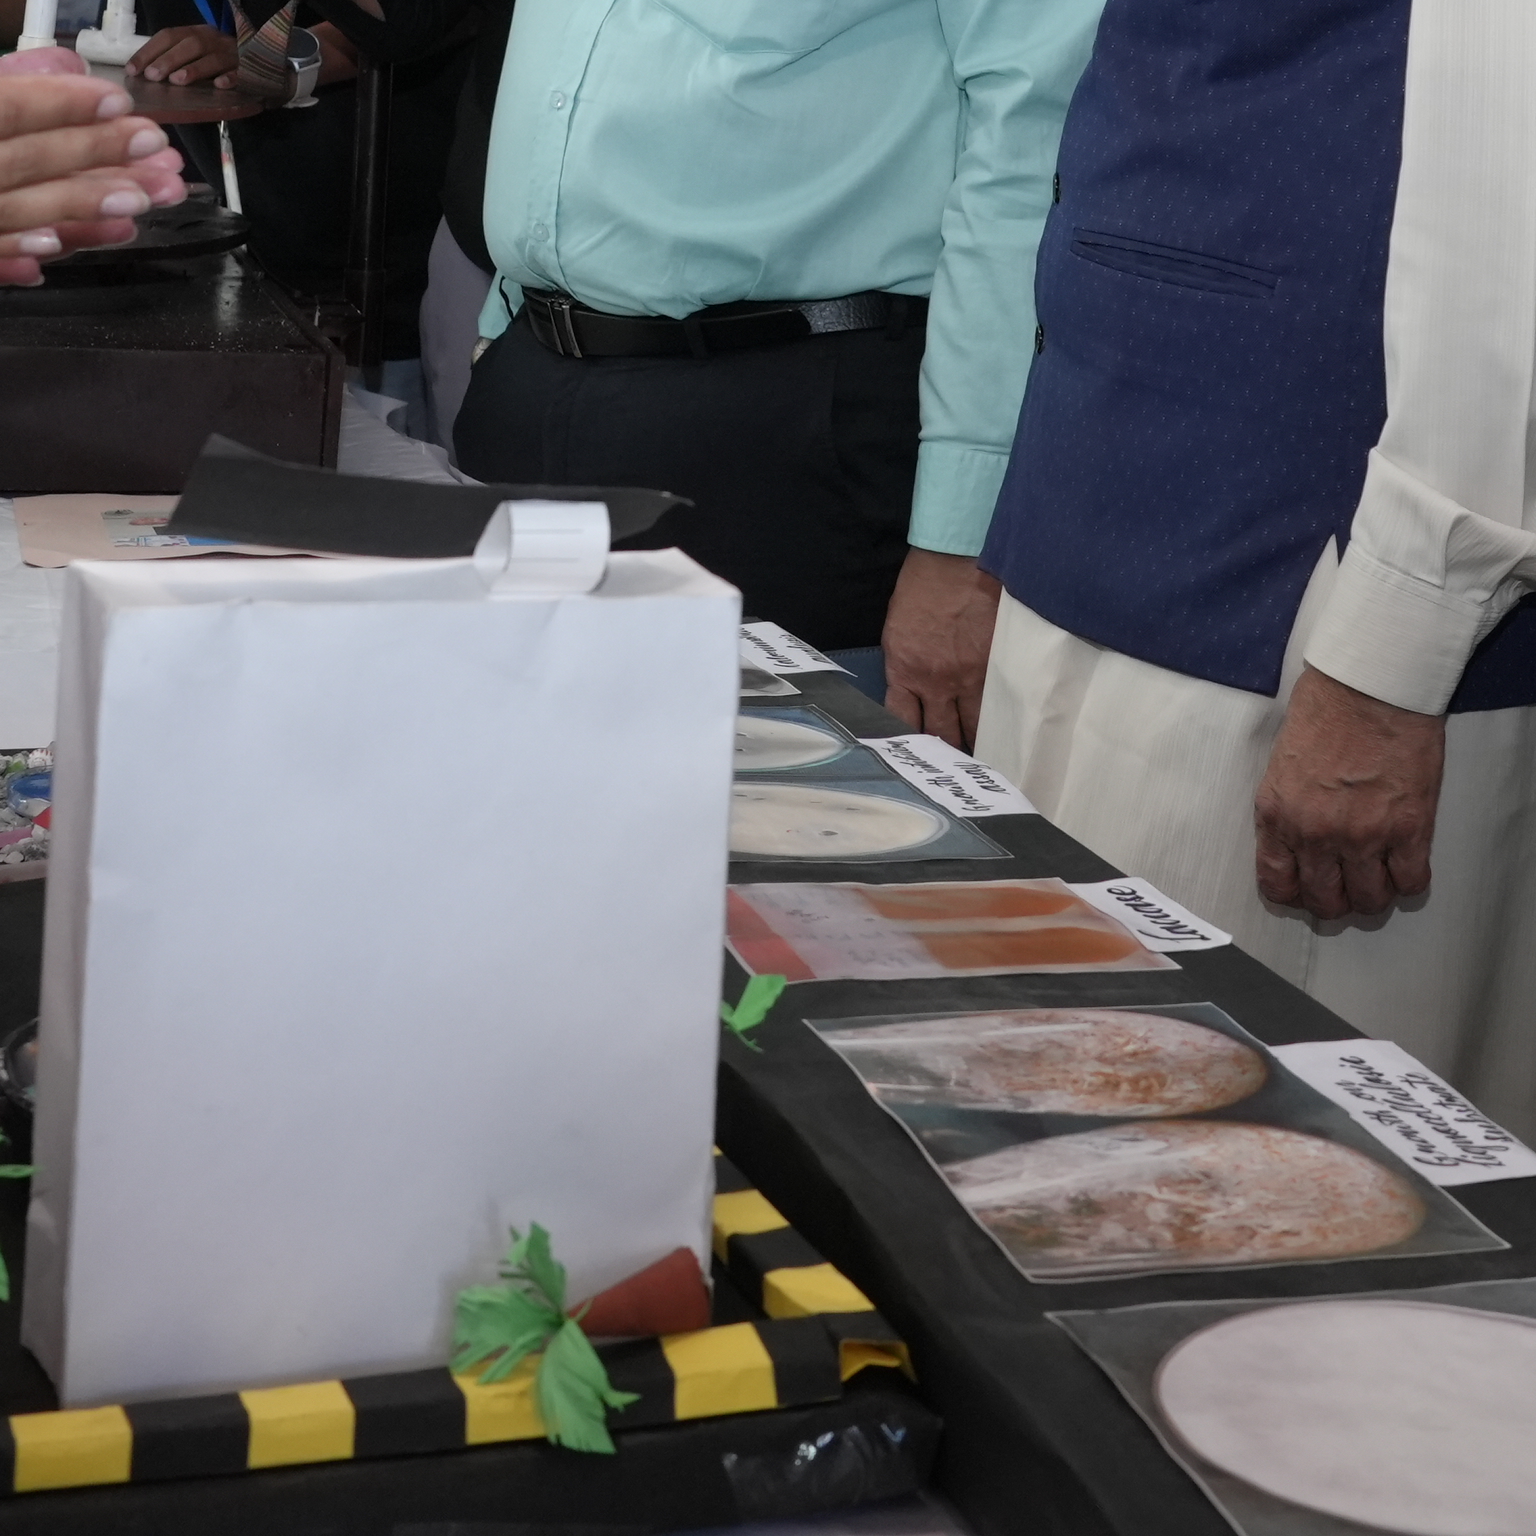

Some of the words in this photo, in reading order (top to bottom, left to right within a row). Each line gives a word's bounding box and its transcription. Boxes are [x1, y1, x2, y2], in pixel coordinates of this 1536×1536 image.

[1106, 883, 1212, 945] Laccase
[1334, 1078, 1385, 1106] on
[1363, 1109, 1460, 1167] Growth
